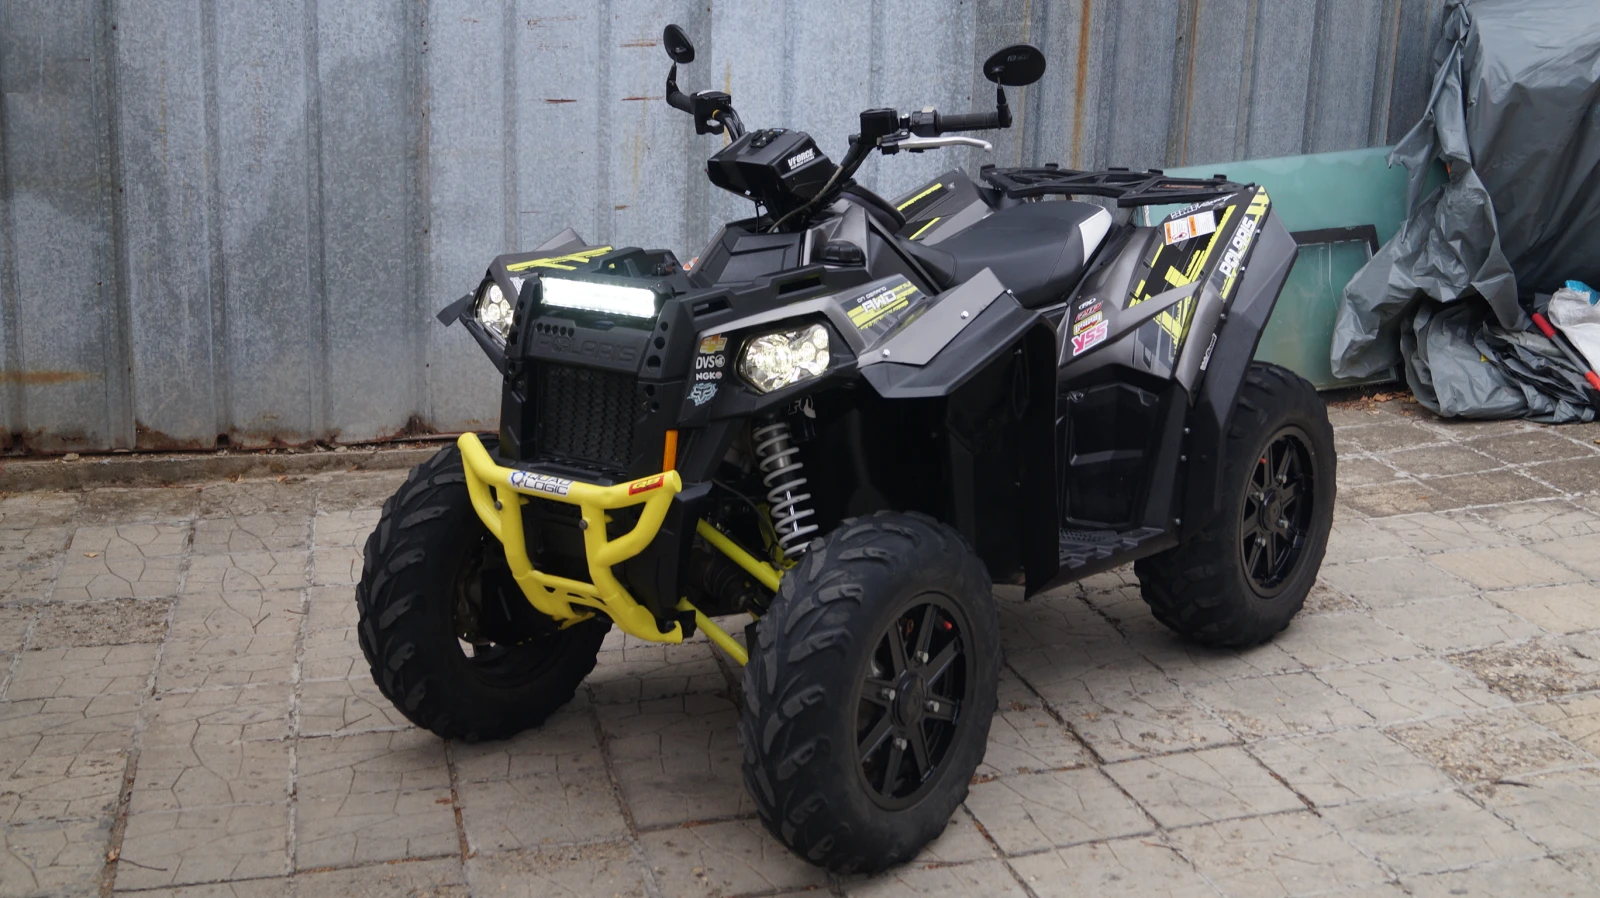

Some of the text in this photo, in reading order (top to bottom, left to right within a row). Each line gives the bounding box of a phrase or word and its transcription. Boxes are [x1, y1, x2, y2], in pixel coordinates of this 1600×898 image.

[787, 148, 814, 167] VFORCE
[1218, 216, 1254, 278] POLARIS
[861, 290, 896, 314] AWD
[1073, 321, 1107, 354] YSS
[537, 334, 635, 363] POLARIS
[696, 355, 715, 369] DVS
[696, 371, 716, 380] NGK
[524, 479, 567, 495] LOGIC
